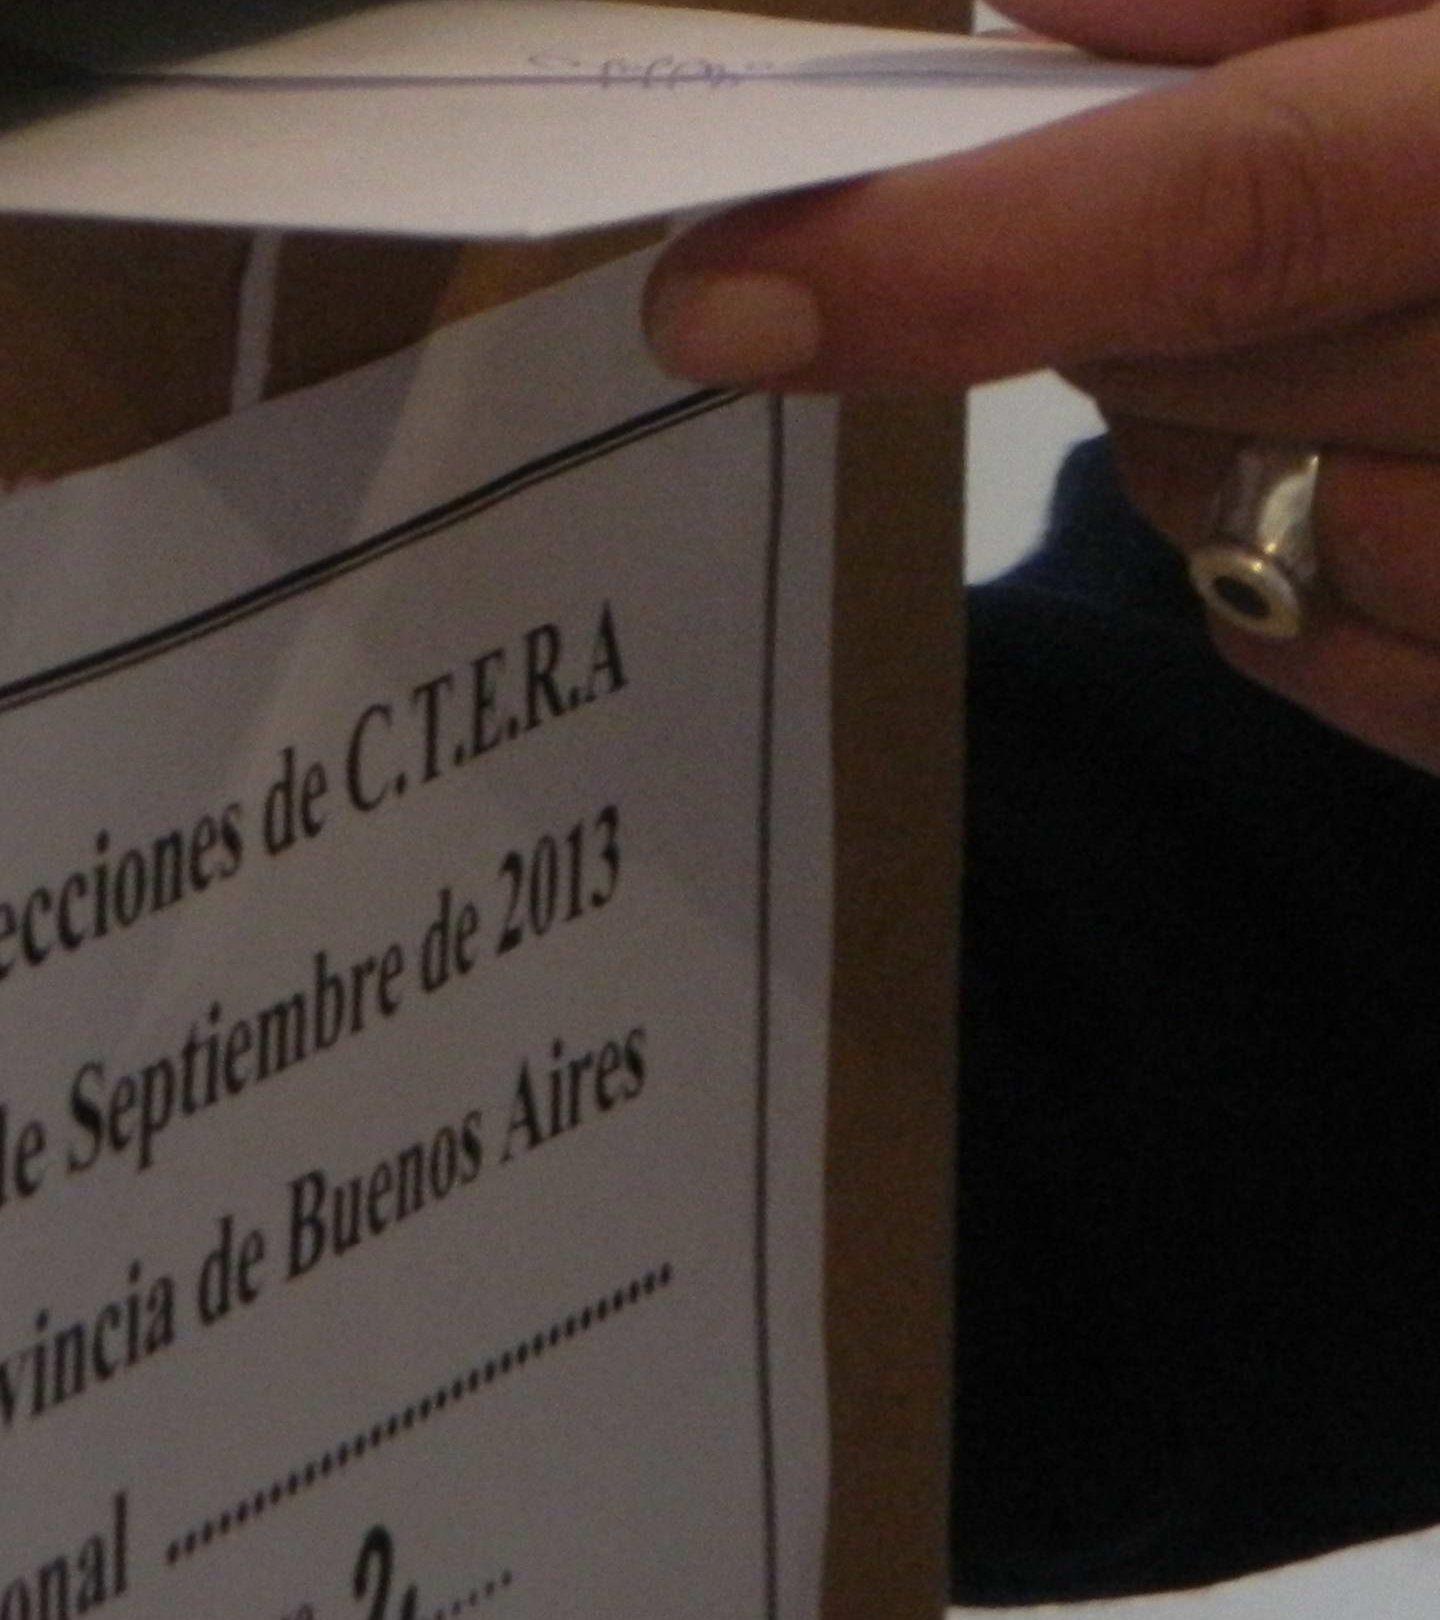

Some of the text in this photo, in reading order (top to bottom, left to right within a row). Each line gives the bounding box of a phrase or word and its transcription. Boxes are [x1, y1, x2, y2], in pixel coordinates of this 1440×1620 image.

[264, 748, 327, 855] de
[347, 600, 629, 813] C.T.E.R.A
[65, 946, 402, 1173] Septiembre
[422, 888, 480, 994] de
[496, 804, 622, 958] 2013
[199, 1216, 262, 1327] de
[287, 1108, 482, 1283] Buenos
[501, 1024, 647, 1162] Aires
